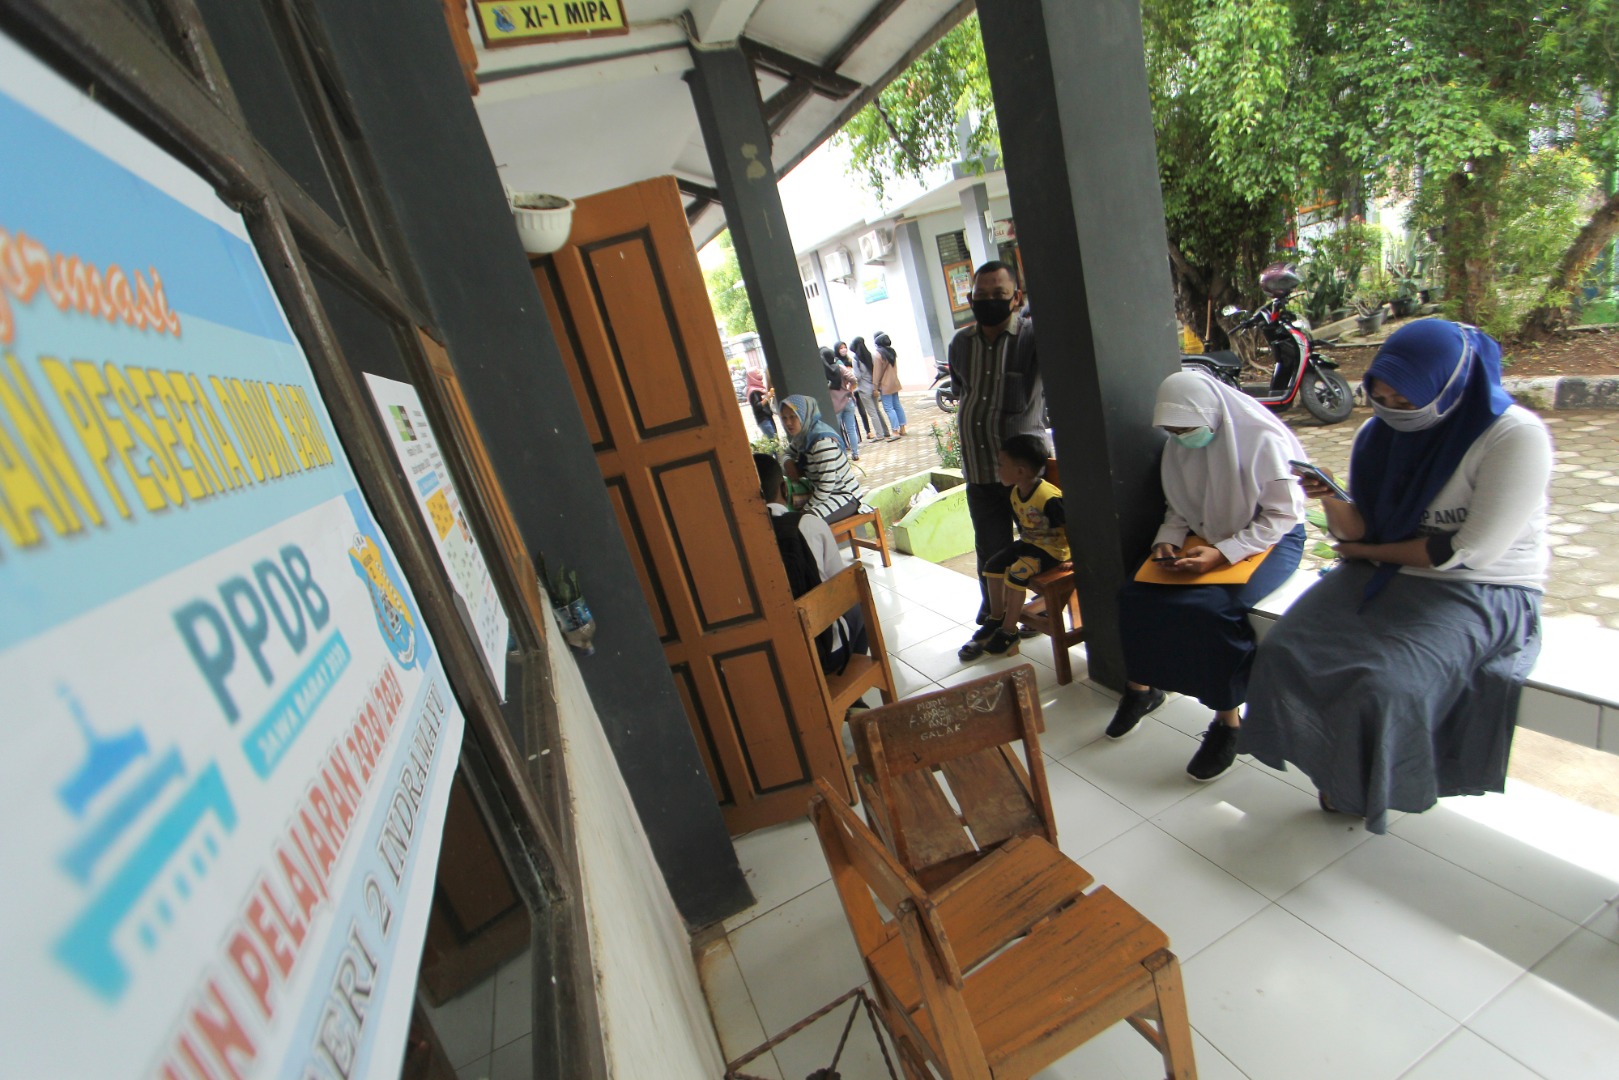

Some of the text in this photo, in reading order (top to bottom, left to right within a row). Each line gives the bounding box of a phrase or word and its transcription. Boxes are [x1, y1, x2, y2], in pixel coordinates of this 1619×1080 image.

[519, 0, 612, 29] XI-1 MIPA
[37, 356, 253, 520] PESERTA
[208, 374, 282, 483] DIDIK
[266, 381, 334, 471] BARU
[171, 541, 331, 727] PPDB
[228, 744, 363, 1023] PELAJARAN
[345, 661, 404, 786] 2020/2021
[377, 679, 445, 887] INDRAMAYU
[363, 875, 392, 939] 2
